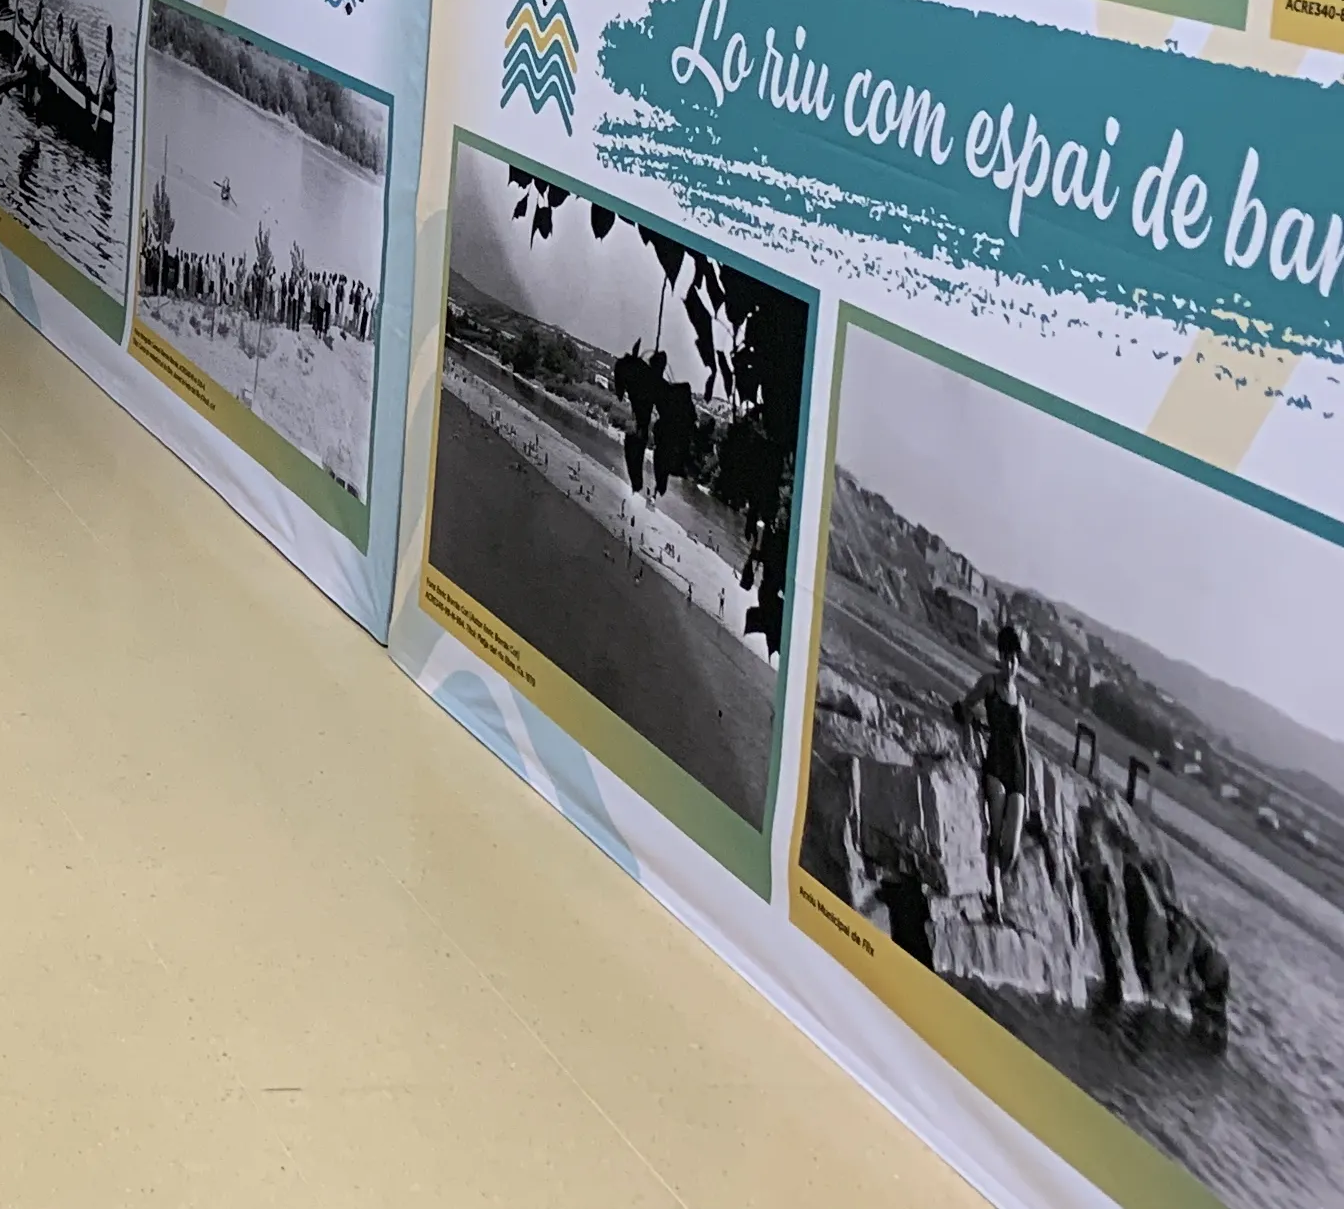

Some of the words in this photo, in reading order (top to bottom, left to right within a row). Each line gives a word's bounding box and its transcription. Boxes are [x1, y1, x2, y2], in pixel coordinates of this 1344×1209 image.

[757, 22, 835, 124] riu
[843, 67, 955, 166] com
[964, 102, 1120, 237] espai
[1132, 128, 1213, 251] de
